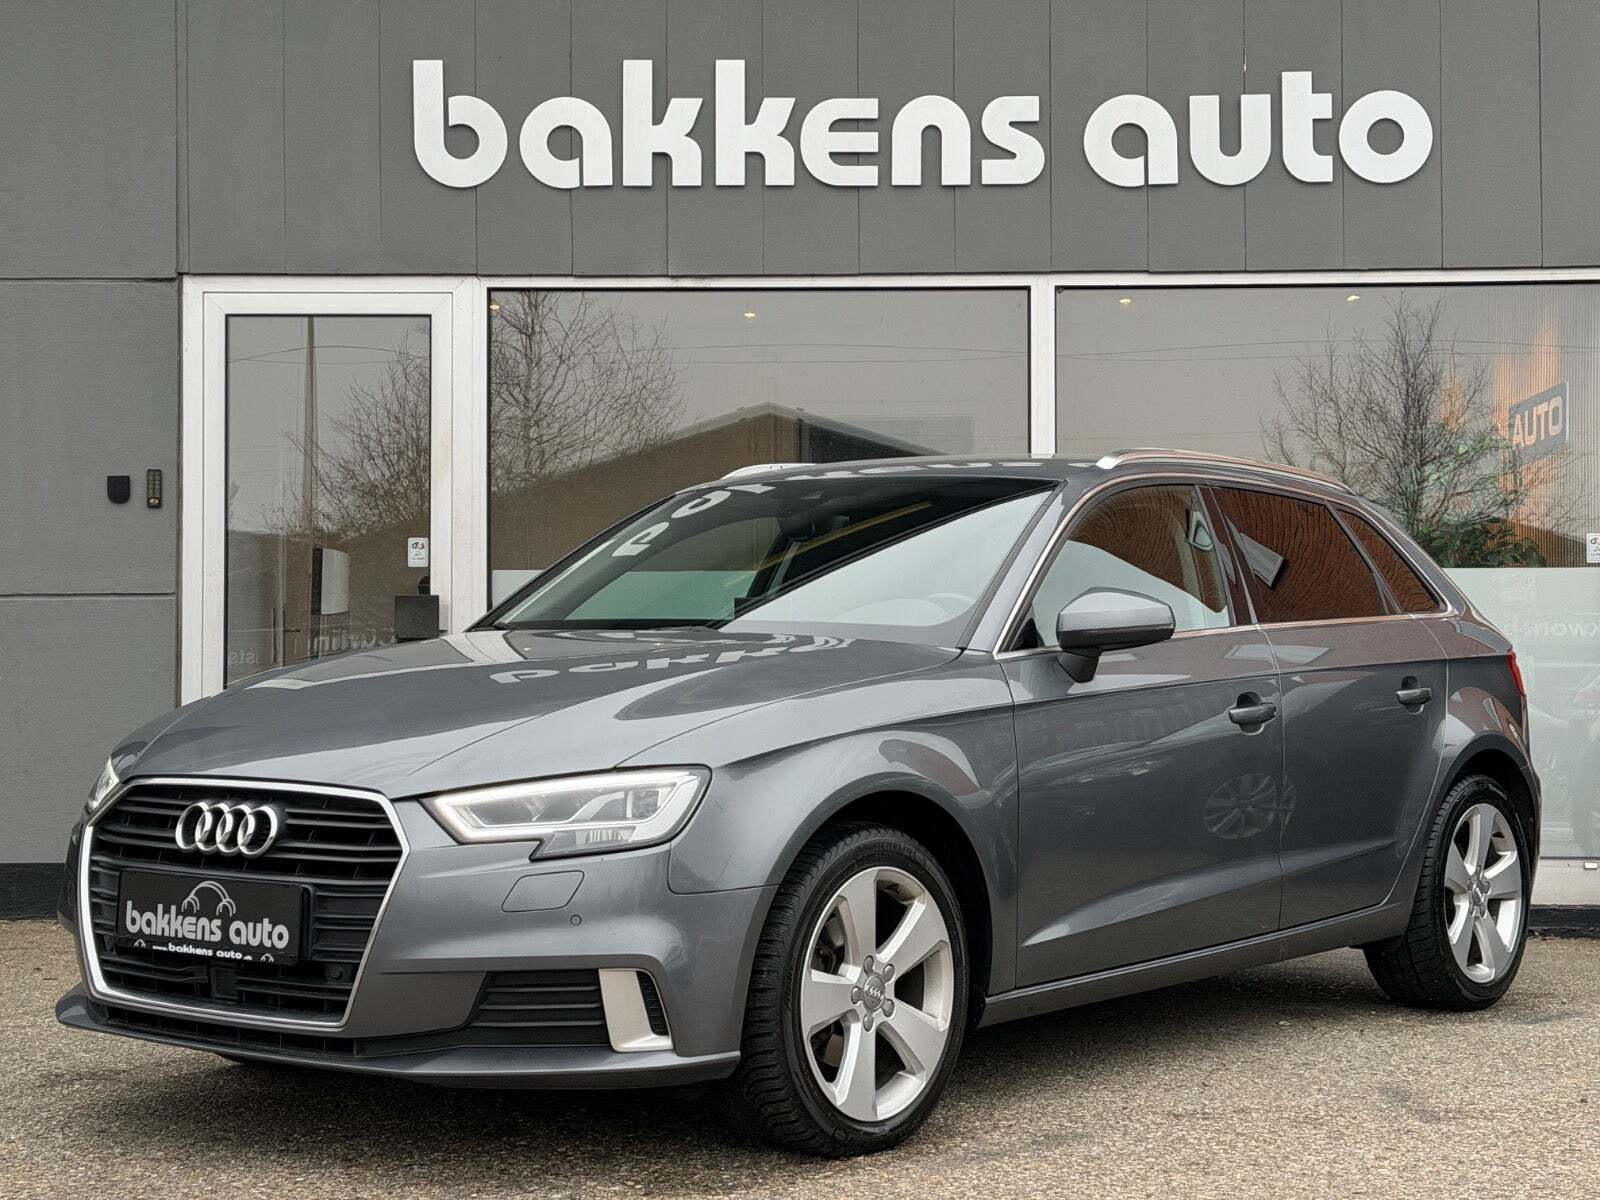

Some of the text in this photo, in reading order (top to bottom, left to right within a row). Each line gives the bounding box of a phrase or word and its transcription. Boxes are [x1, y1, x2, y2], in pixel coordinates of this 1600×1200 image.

[412, 59, 1434, 189] bakkens auto
[1513, 396, 1562, 448] AUTO
[126, 900, 289, 949] bakkens auto
